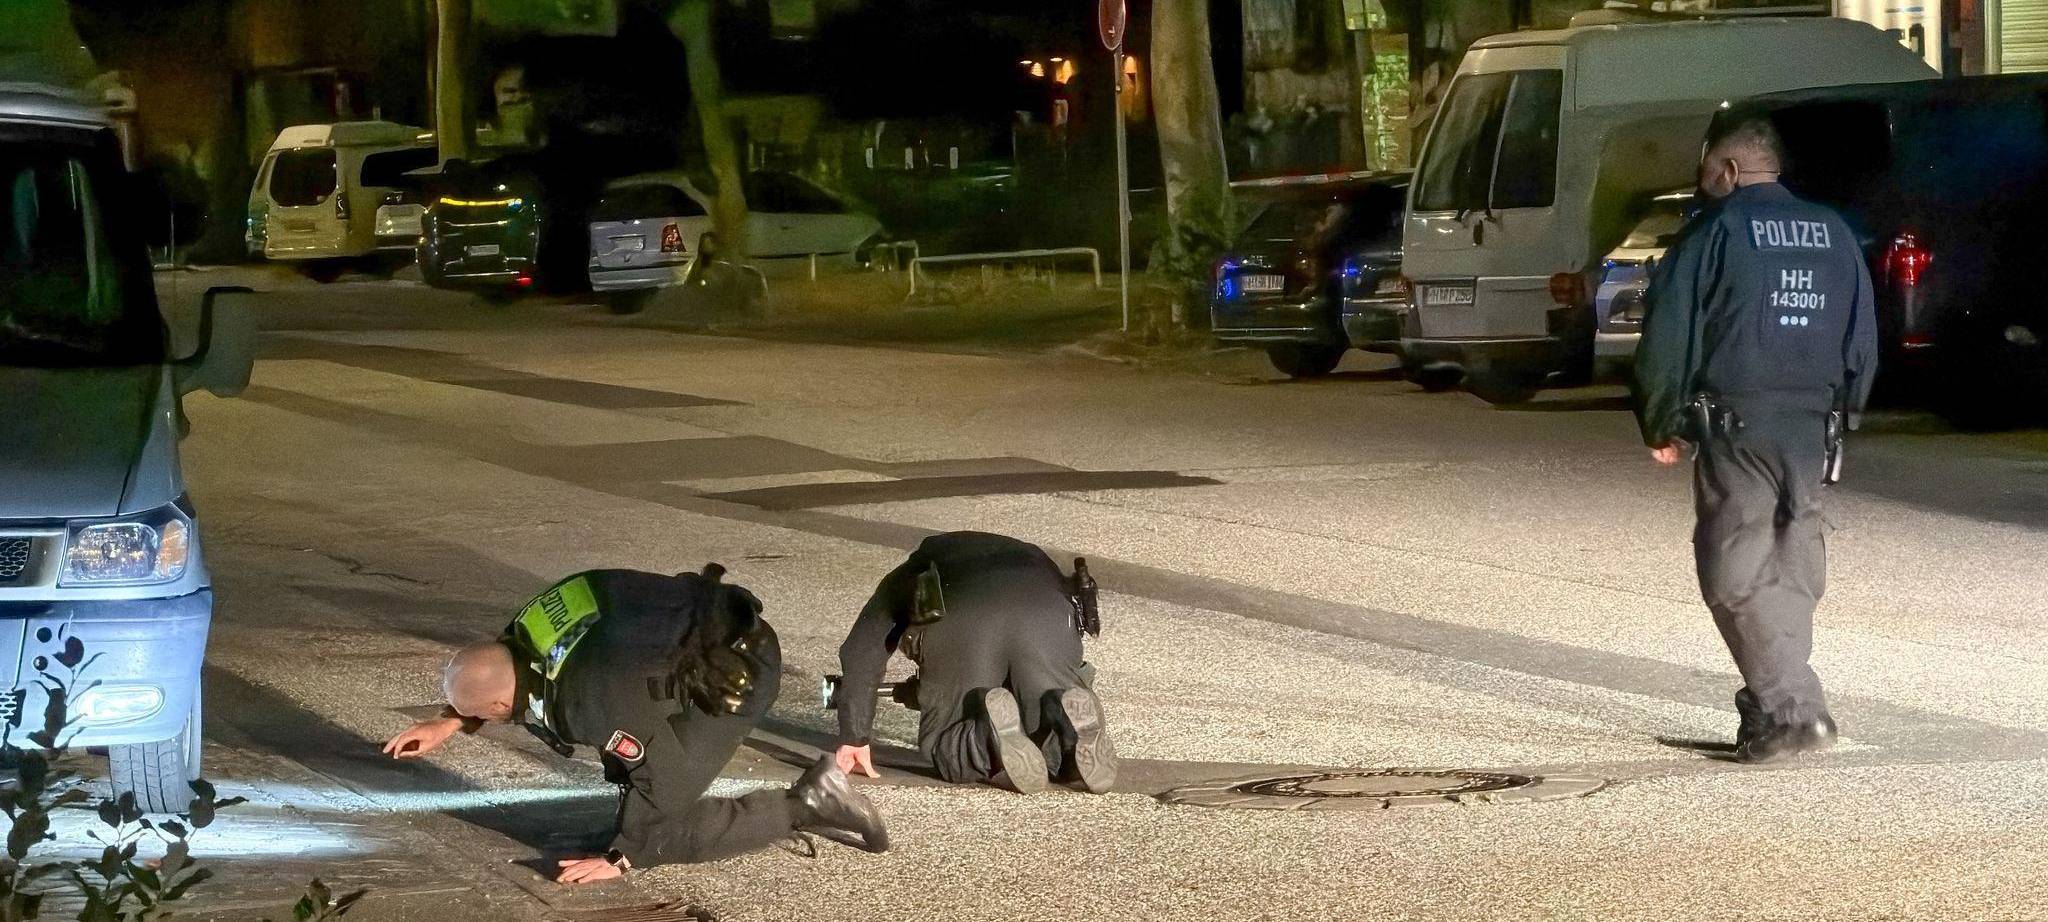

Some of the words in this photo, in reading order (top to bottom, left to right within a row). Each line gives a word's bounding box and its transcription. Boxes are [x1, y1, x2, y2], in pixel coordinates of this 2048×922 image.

[1751, 219, 1831, 248] POLIZEI
[1781, 269, 1813, 289] HH
[1770, 291, 1825, 309] 143001
